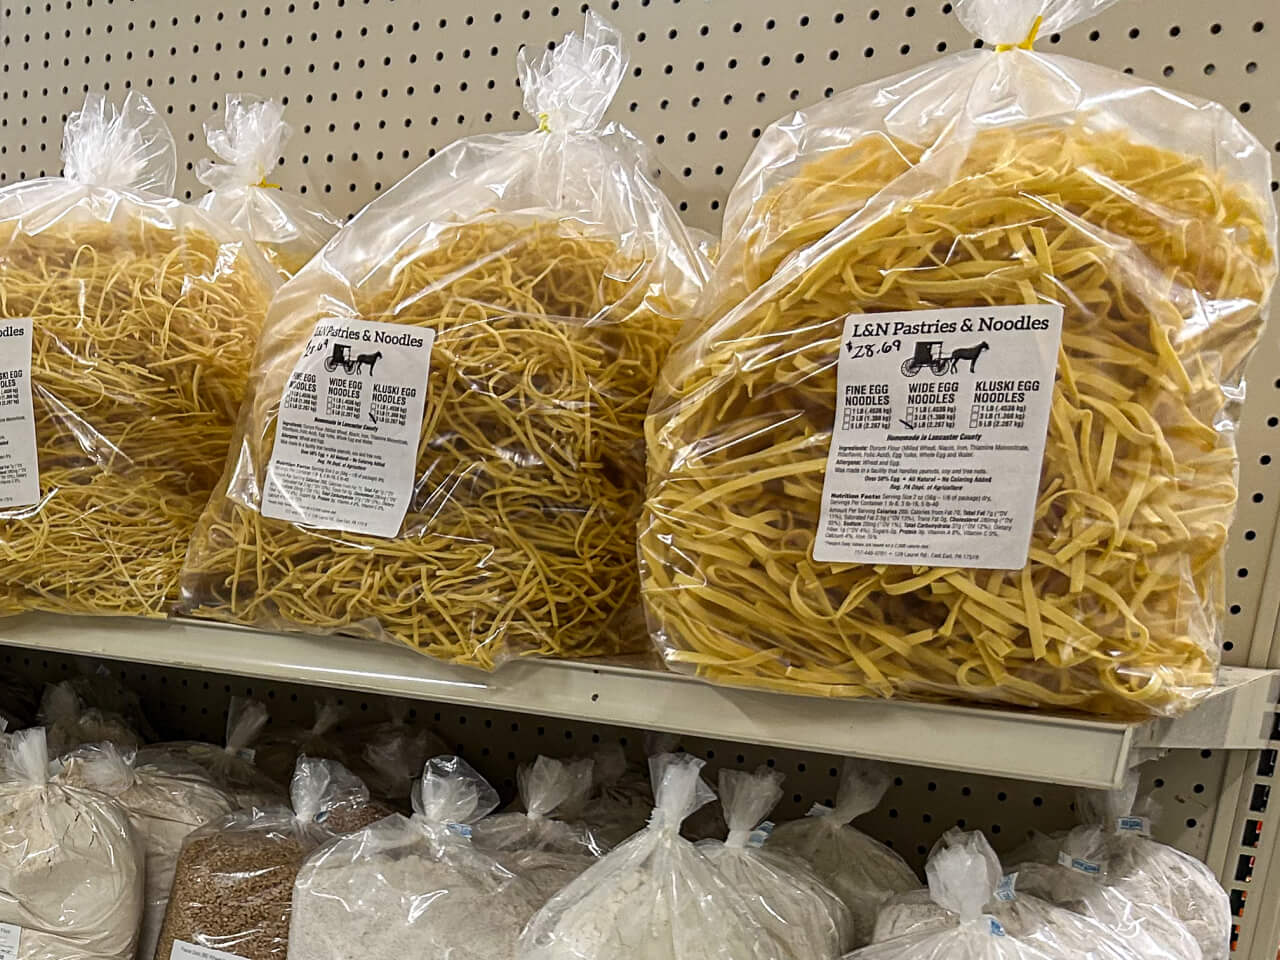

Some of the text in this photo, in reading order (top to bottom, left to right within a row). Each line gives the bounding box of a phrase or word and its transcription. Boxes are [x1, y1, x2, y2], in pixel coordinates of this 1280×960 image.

[852, 315, 1049, 338] L&N Pastries & Noodles
[362, 329, 371, 342] &
[374, 330, 424, 348] Noodles
[845, 339, 902, 360] $28.69
[329, 377, 363, 390] WIDE EGG
[845, 384, 888, 396] FINE EGG
[908, 381, 959, 393] WIDE EGG
[975, 379, 1040, 392] KLUSKI EGG
[328, 387, 360, 399] NOODLES
[373, 383, 417, 398] KLUSKI EGG
[372, 393, 406, 406] NOODLES
[845, 395, 890, 406] NOODLES
[908, 393, 955, 405] NOODLES
[973, 392, 1025, 404] NOODLES
